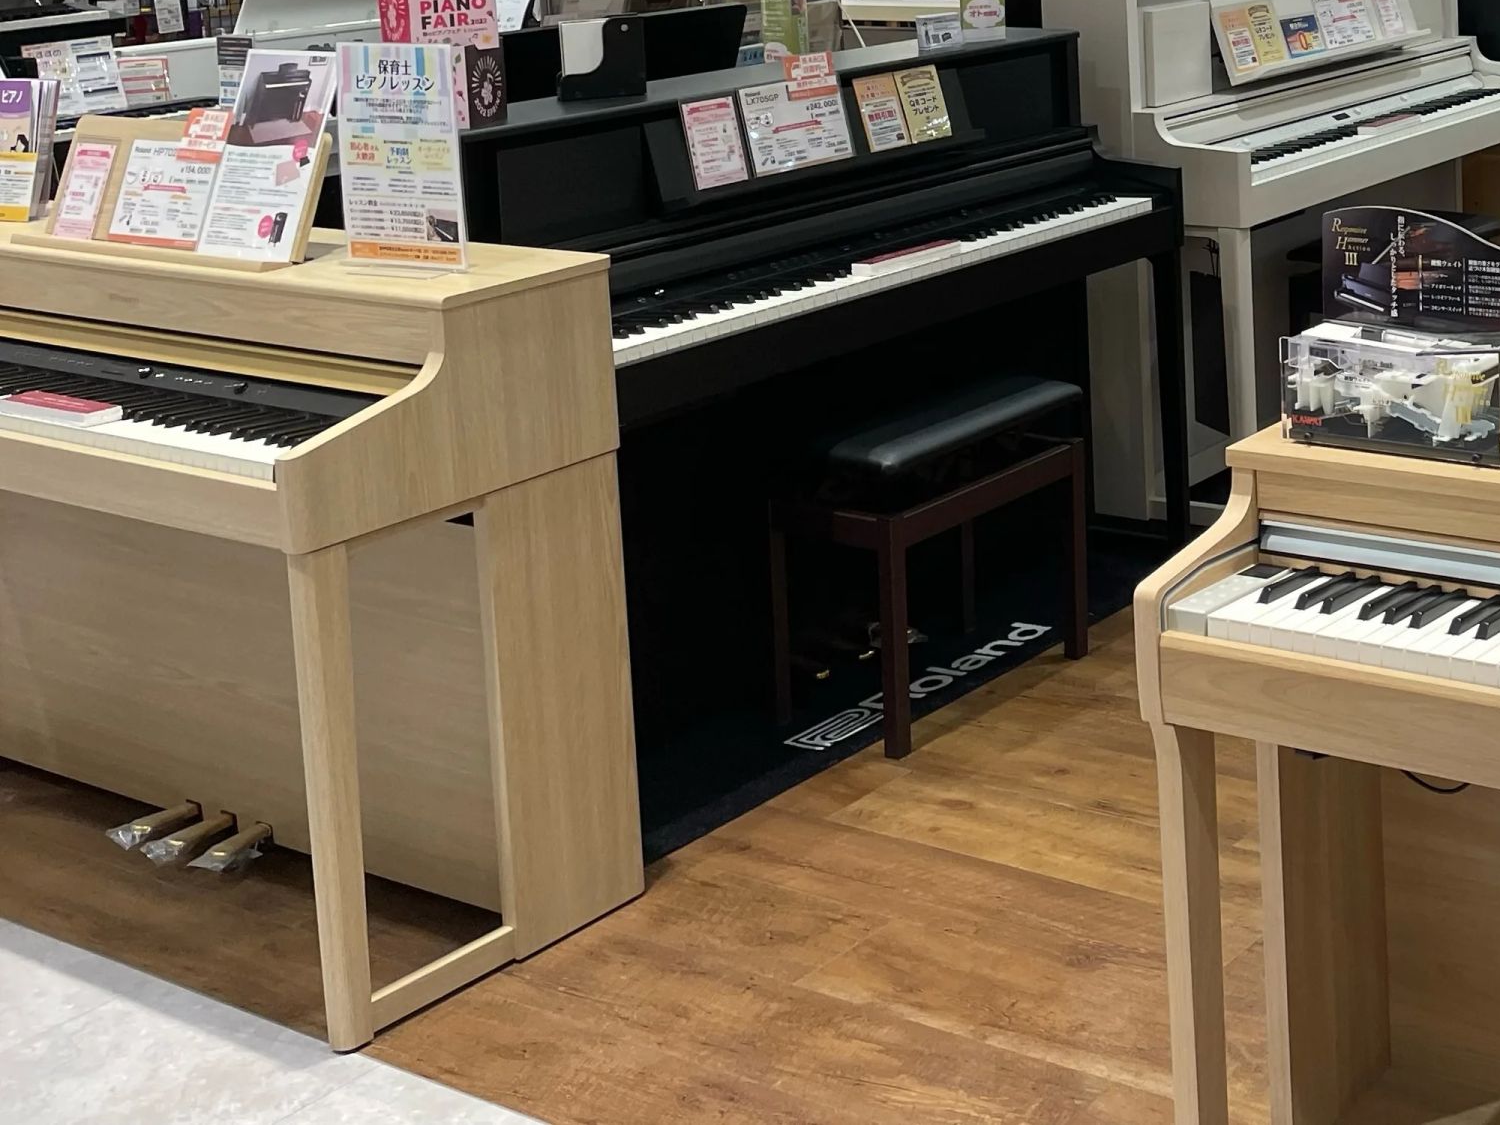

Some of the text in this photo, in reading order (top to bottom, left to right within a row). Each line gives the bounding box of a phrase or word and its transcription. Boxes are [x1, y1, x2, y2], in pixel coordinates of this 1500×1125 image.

[421, 13, 470, 30] FAIR
[378, 59, 412, 76] 保育士
[356, 76, 435, 92] ピアノレッスン
[1, 90, 22, 103] ピアノ
[745, 94, 779, 106] LX705GP
[386, 156, 412, 165] レッスン
[1344, 253, 1358, 266] III
[905, 622, 1052, 699] oland
